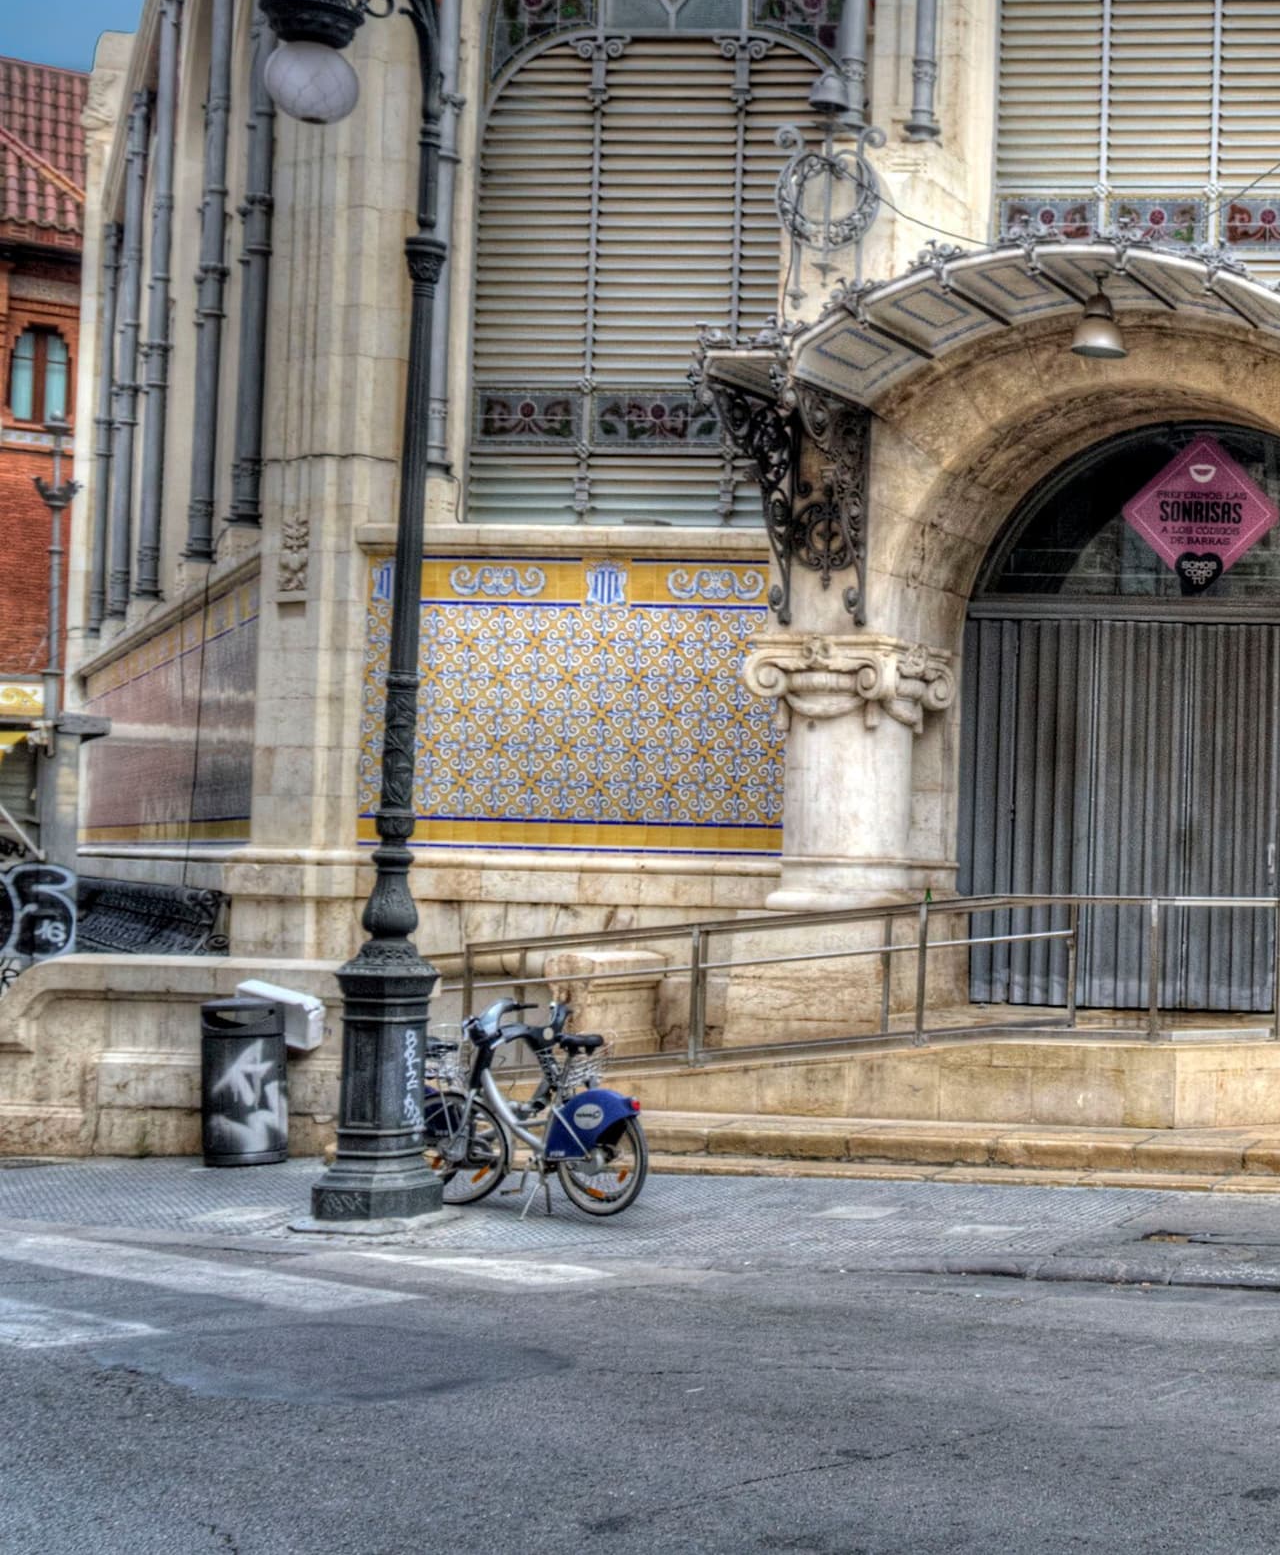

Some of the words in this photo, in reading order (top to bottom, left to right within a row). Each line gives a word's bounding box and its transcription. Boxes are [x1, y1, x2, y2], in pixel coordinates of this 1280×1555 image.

[1157, 491, 1223, 501] PREFERIMOS
[1160, 500, 1242, 524] SONRISAS
[1172, 527, 1193, 535] LOS
[1170, 536, 1185, 545] DE
[1187, 537, 1231, 546] BARRAS
[1182, 561, 1217, 569] SOMOS
[1185, 569, 1213, 577] COMO
